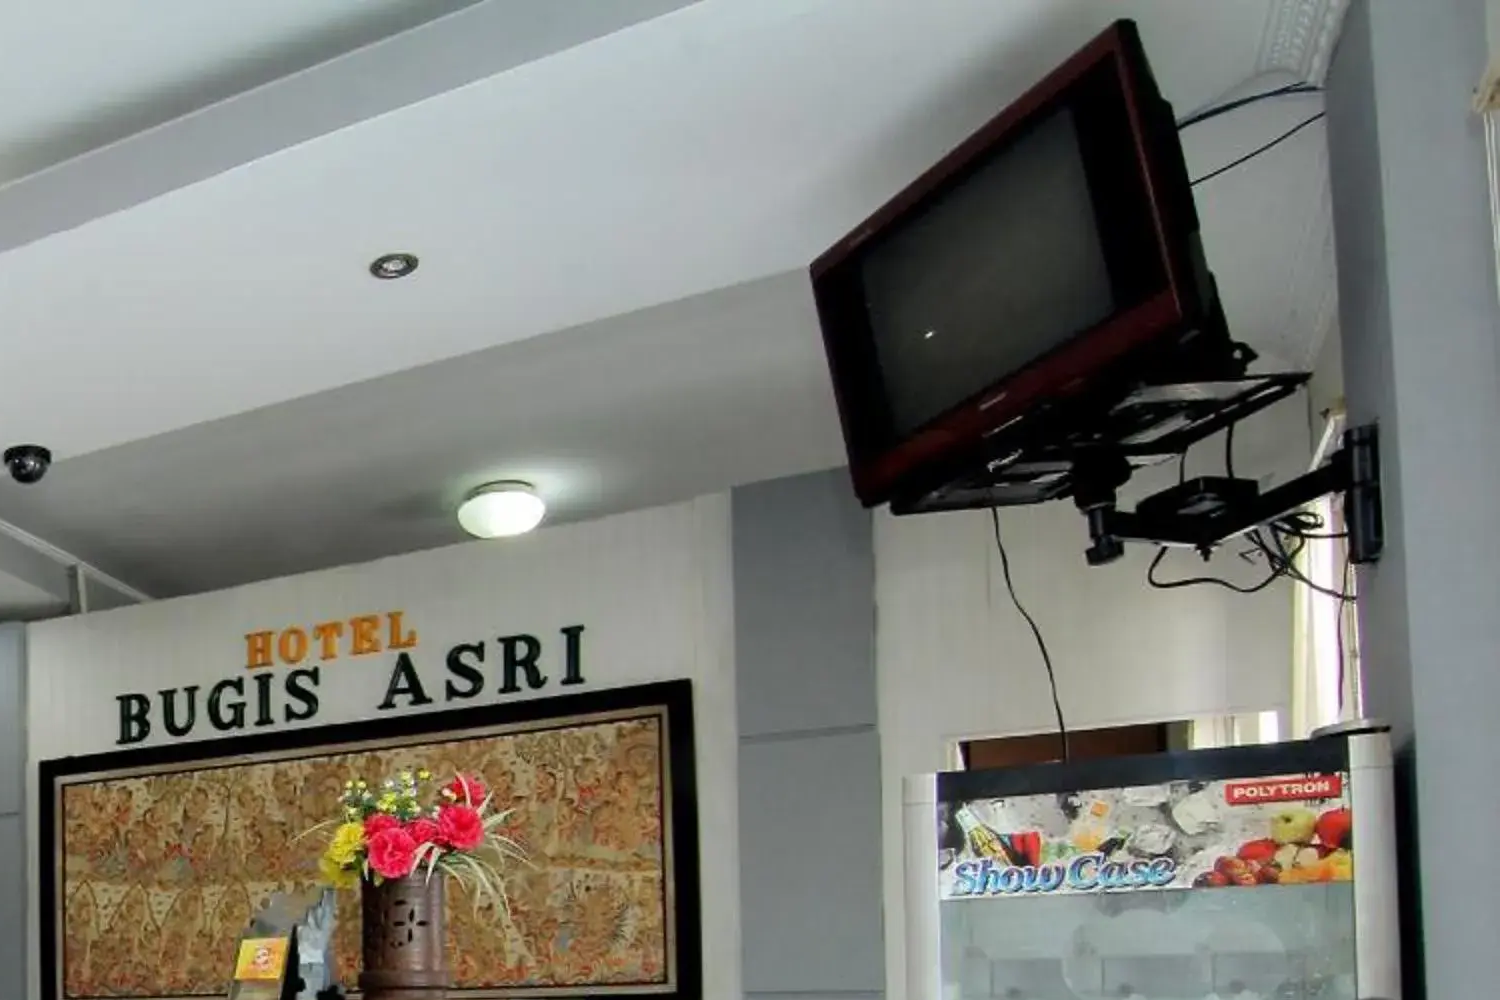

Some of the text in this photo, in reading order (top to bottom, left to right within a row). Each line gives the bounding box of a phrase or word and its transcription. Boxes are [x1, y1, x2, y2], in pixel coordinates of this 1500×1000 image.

[243, 611, 418, 669] HOTEL
[115, 624, 585, 745] BUGIS ASRI
[1232, 780, 1330, 799] POLYTRON
[953, 852, 1178, 895] Show Case
